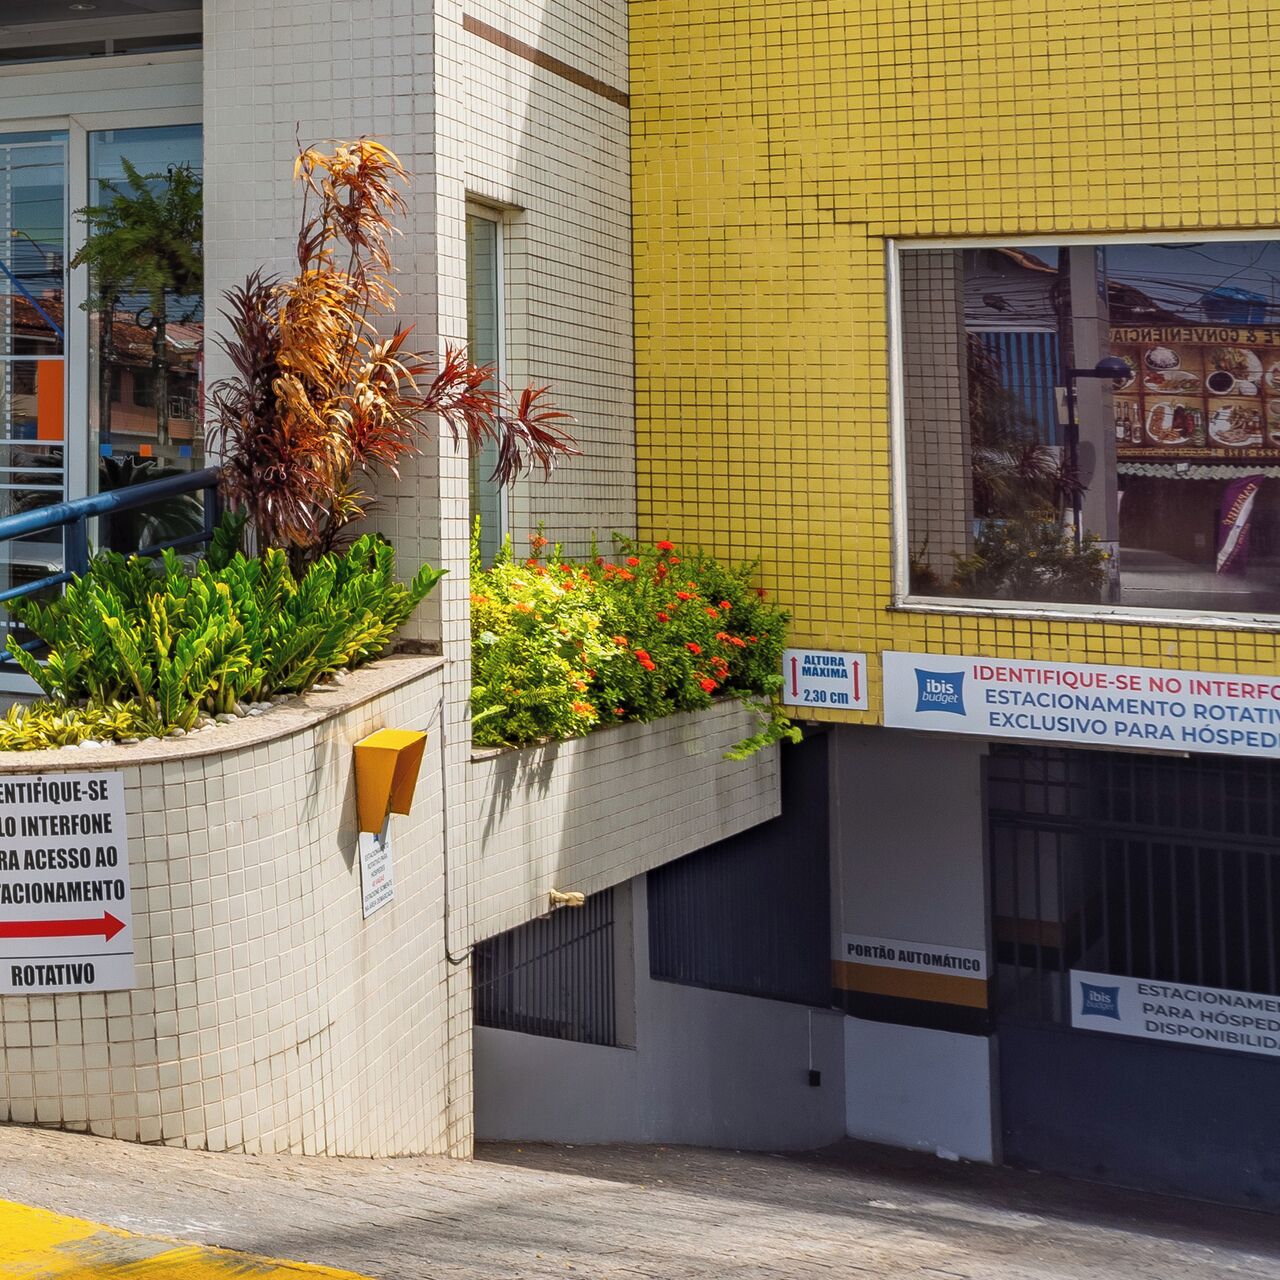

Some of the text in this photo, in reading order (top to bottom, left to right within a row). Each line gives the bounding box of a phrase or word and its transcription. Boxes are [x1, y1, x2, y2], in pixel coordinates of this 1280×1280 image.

[801, 666, 848, 679] MÁXIMA
[804, 655, 845, 667] ALTURA
[926, 679, 954, 694] ibis
[973, 665, 1141, 691] IDENTIFIQUE-SE
[1149, 677, 1182, 694] NO
[803, 689, 848, 704] 2,30 cm
[922, 692, 959, 704] budget
[985, 689, 1186, 718] ESTACIONAMENTO
[989, 712, 1280, 749] EXCLUSIVO PARA HÓSPED
[21, 813, 112, 837] INTERFONE
[24, 847, 90, 870] ACESSO
[95, 846, 118, 867] AO
[847, 943, 981, 972] PORTÃO AUTOMÁTICO
[11, 963, 95, 986] ROTATIVO
[1089, 990, 1112, 1003] ibis
[1138, 983, 1280, 1013] ESTACIONAME
[1143, 1002, 1194, 1021] PARA
[1145, 1020, 1280, 1050] DISPONIBILID
